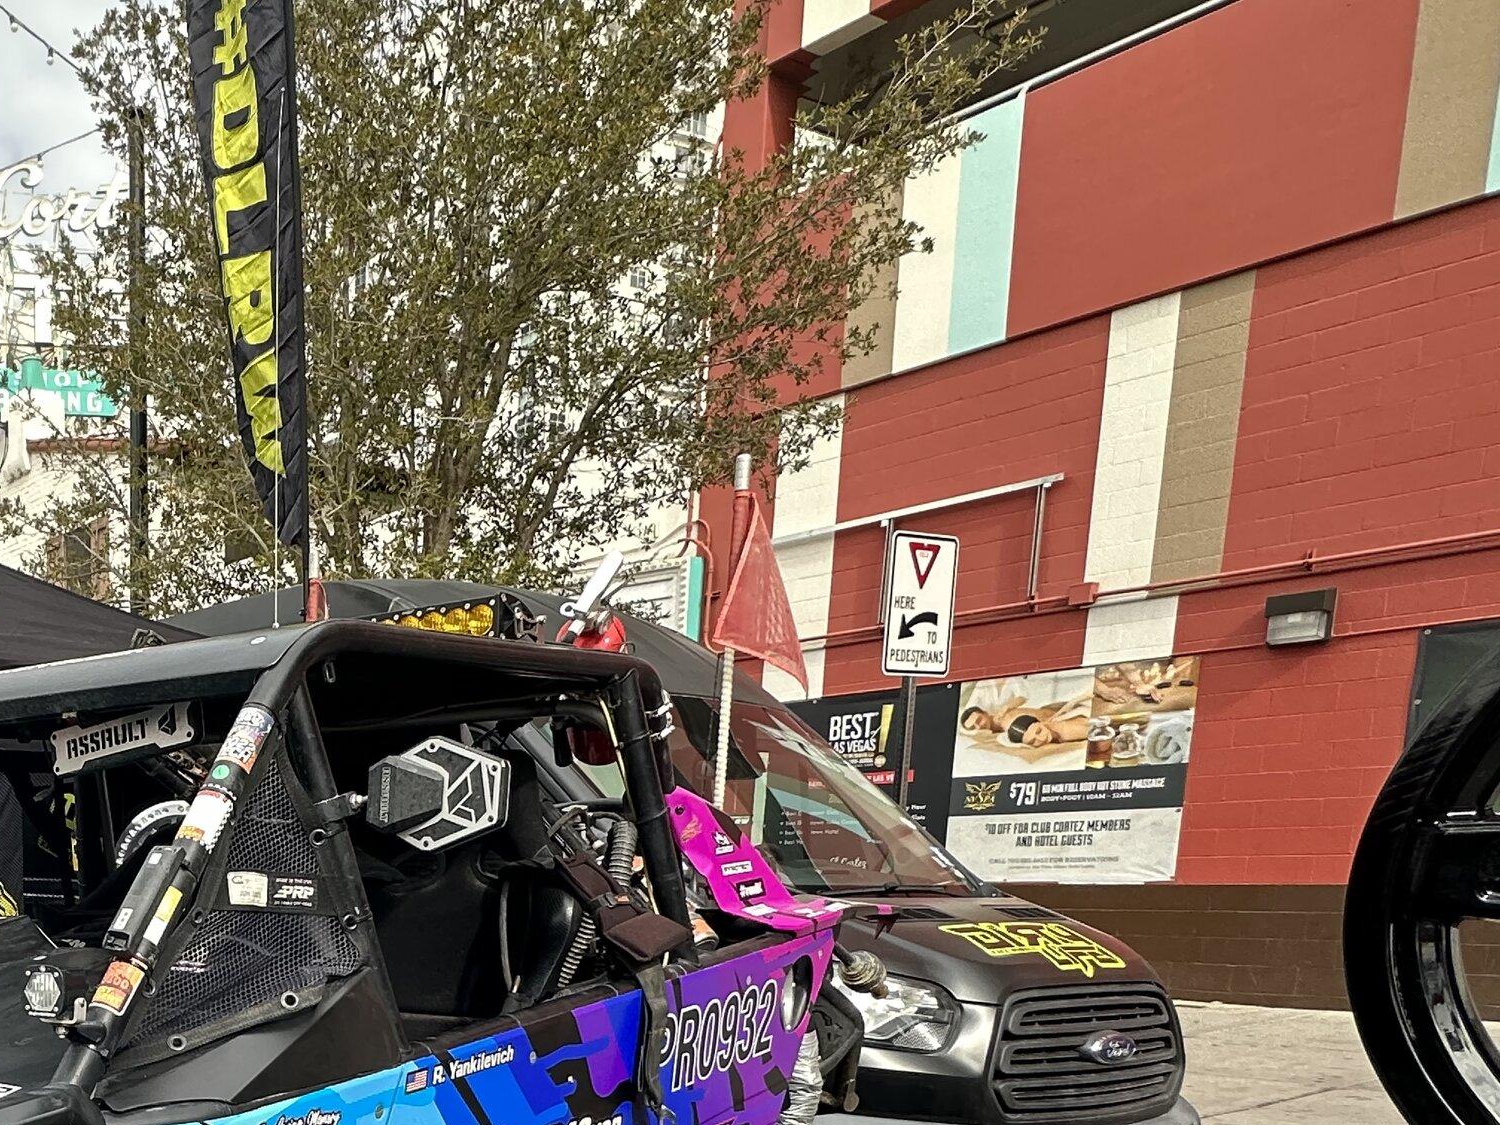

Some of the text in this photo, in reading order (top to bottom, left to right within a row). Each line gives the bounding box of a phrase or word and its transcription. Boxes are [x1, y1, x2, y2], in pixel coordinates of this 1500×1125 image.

[894, 596, 916, 610] HERE
[927, 631, 938, 645] TO
[890, 649, 944, 664] PEDESTRIANS
[829, 712, 880, 742] BEST
[67, 717, 148, 760] ASSAULT
[846, 739, 877, 753] VEGAS
[1009, 782, 1036, 807] $79
[1065, 782, 1078, 792] FULL
[1079, 781, 1096, 791] BODY
[1110, 779, 1132, 790] STONE
[1132, 777, 1166, 789] MASSAGE
[997, 822, 1013, 835] OFF
[1013, 821, 1029, 834] FOR
[1031, 820, 1051, 834] CLUB
[1053, 820, 1085, 832] CORTEZ
[1086, 819, 1131, 832] MEMBERS
[1015, 834, 1093, 847] AND HOTEL GUESTS
[273, 885, 315, 899] PRP
[432, 1045, 514, 1085] R. Yankilevich
